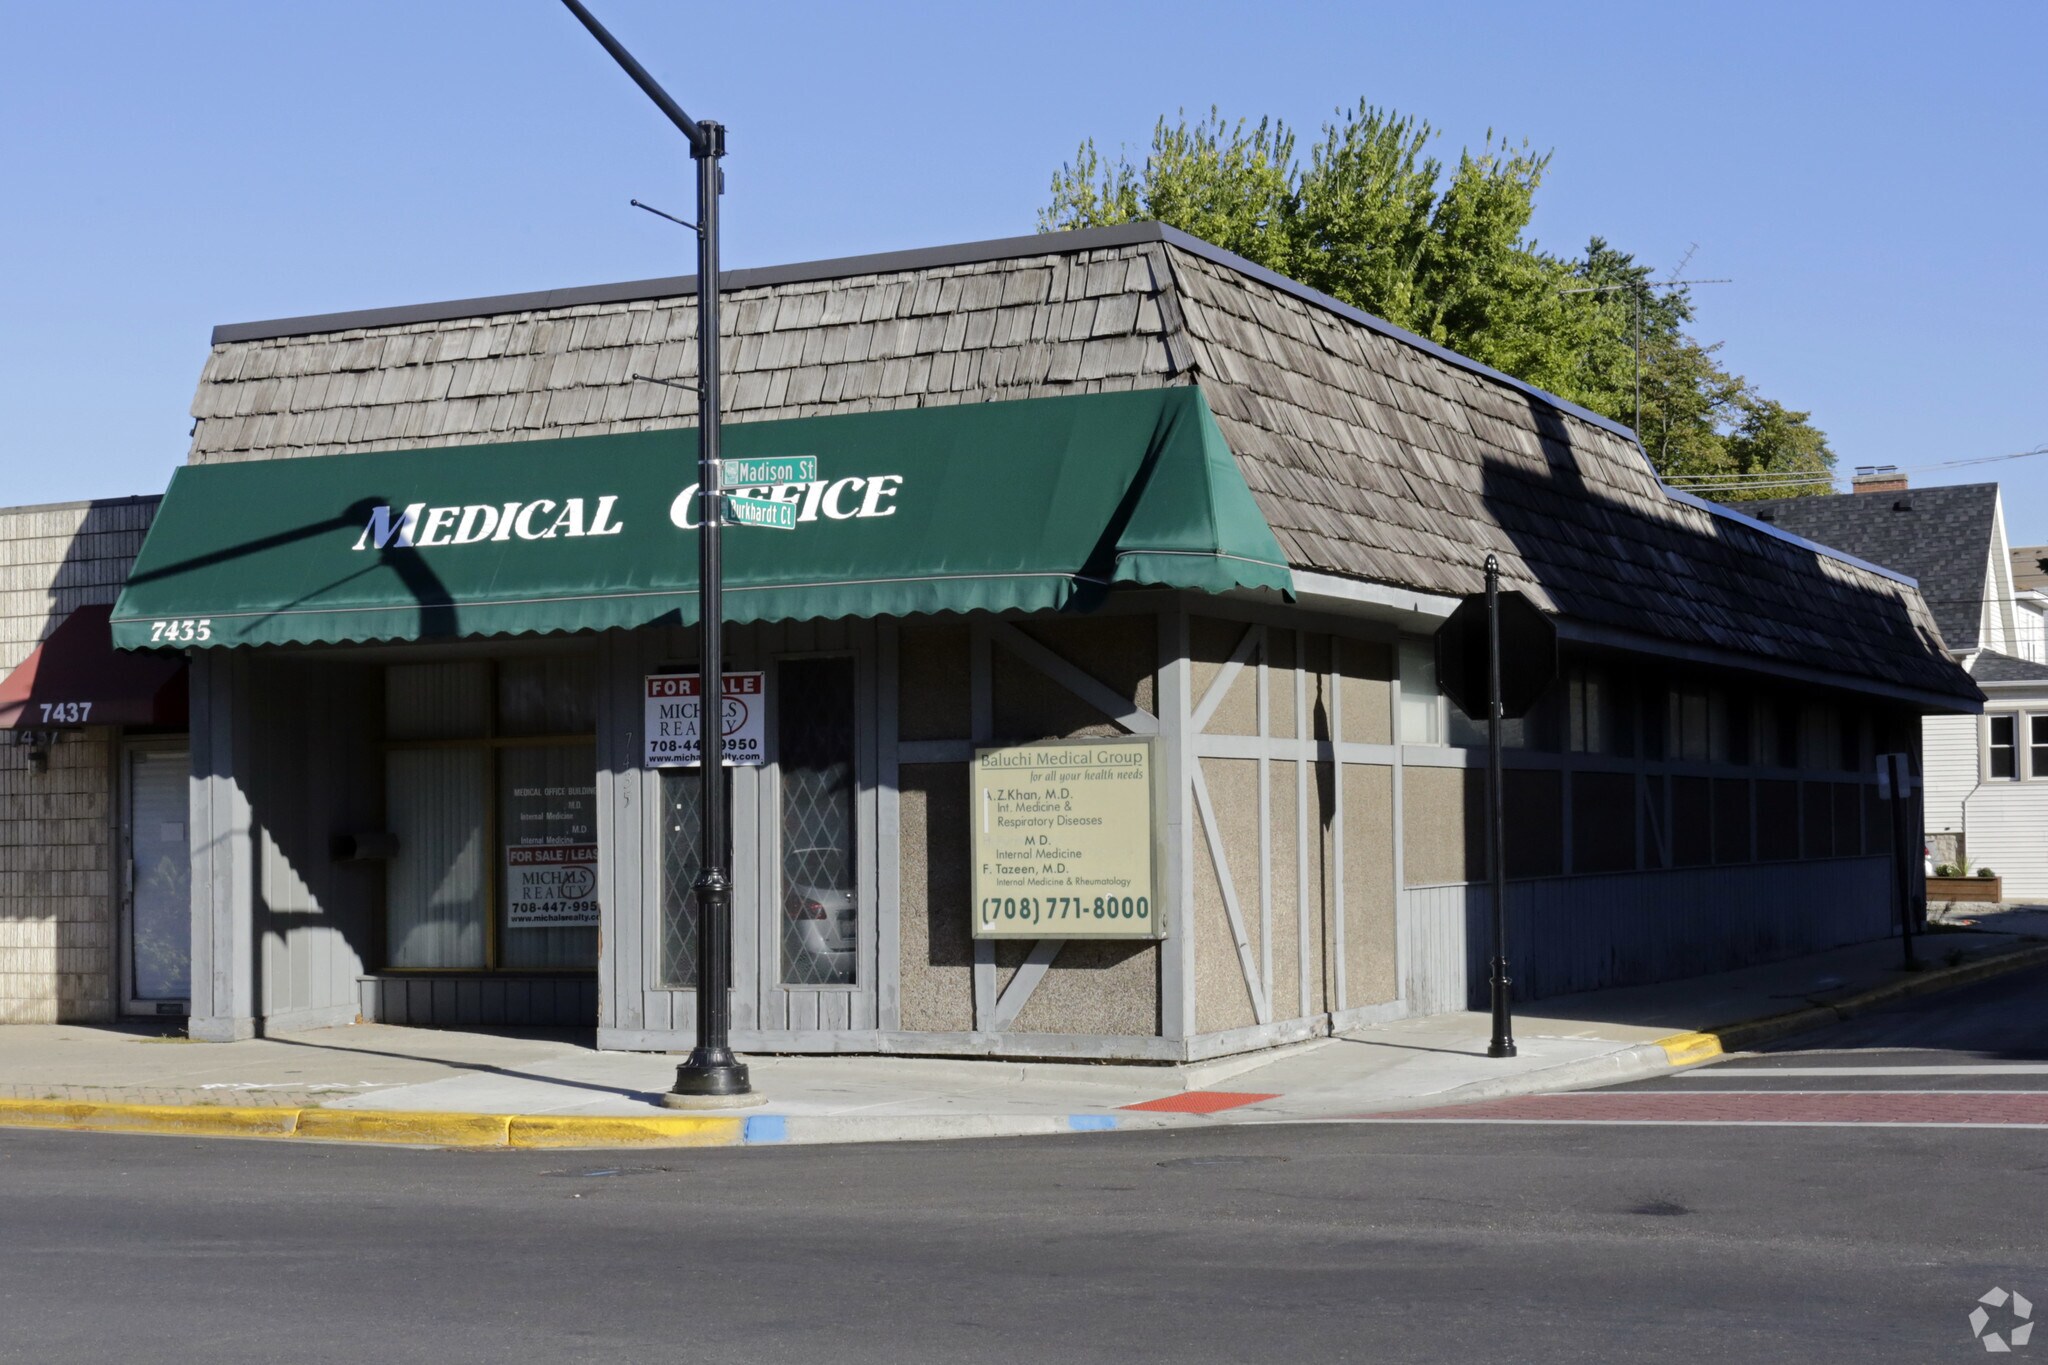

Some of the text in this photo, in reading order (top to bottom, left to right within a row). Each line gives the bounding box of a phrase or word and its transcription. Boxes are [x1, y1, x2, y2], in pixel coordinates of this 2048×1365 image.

[739, 460, 814, 483] Madison St
[731, 499, 791, 525] Burkhardt Ct
[352, 494, 624, 550] MEDICAL
[150, 618, 211, 642] 7435
[652, 680, 691, 696] FOR
[40, 702, 93, 723] 7437
[660, 720, 737, 737] REAY
[981, 749, 1143, 767] Baluchi Medical Group
[1030, 768, 1144, 783] for all your health needs
[514, 788, 542, 797] MEDICAL
[545, 787, 566, 796] OFFICE
[1045, 787, 1073, 800] M.D.
[997, 800, 1072, 813] Int. Medicine &
[520, 811, 574, 820] Internal Medicine
[997, 814, 1103, 829] Respiratory Diseases
[520, 836, 574, 845] Internal Medicine
[510, 851, 532, 862] FOR
[535, 849, 563, 861] SALE
[571, 848, 598, 860] LEAS
[996, 847, 1083, 860] Internal Medicine
[983, 863, 1069, 876] F. Tazeen, M.D.
[522, 870, 587, 885] MICHALS
[996, 876, 1132, 888] Internal Medicine & Rheumatology
[523, 885, 587, 899] REALTY
[512, 901, 598, 914] 708-447-995
[982, 896, 1149, 925] (708) 771-8000
